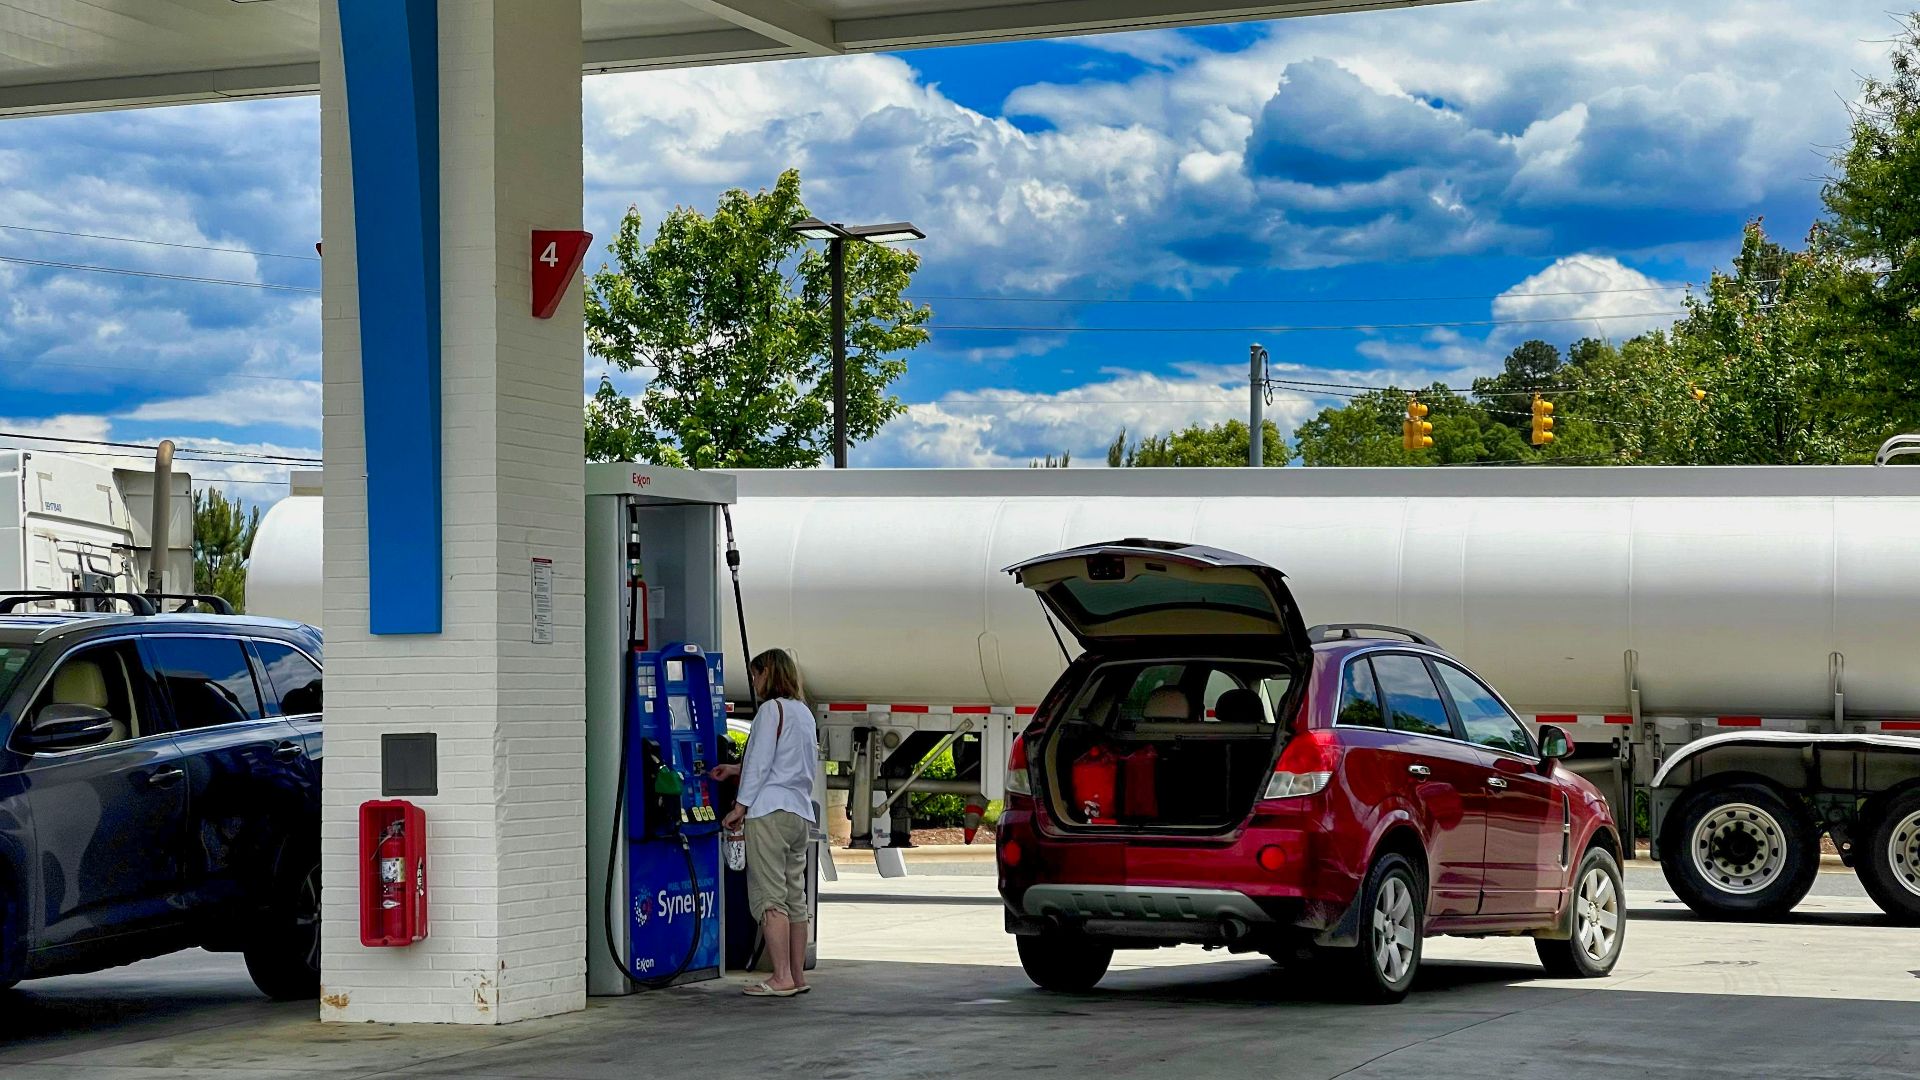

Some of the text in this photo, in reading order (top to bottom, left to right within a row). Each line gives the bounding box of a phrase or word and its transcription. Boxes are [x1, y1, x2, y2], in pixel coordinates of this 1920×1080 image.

[540, 241, 558, 267] 4
[632, 472, 651, 488] Exxon
[716, 659, 722, 673] 4
[636, 957, 655, 973] Exxon
